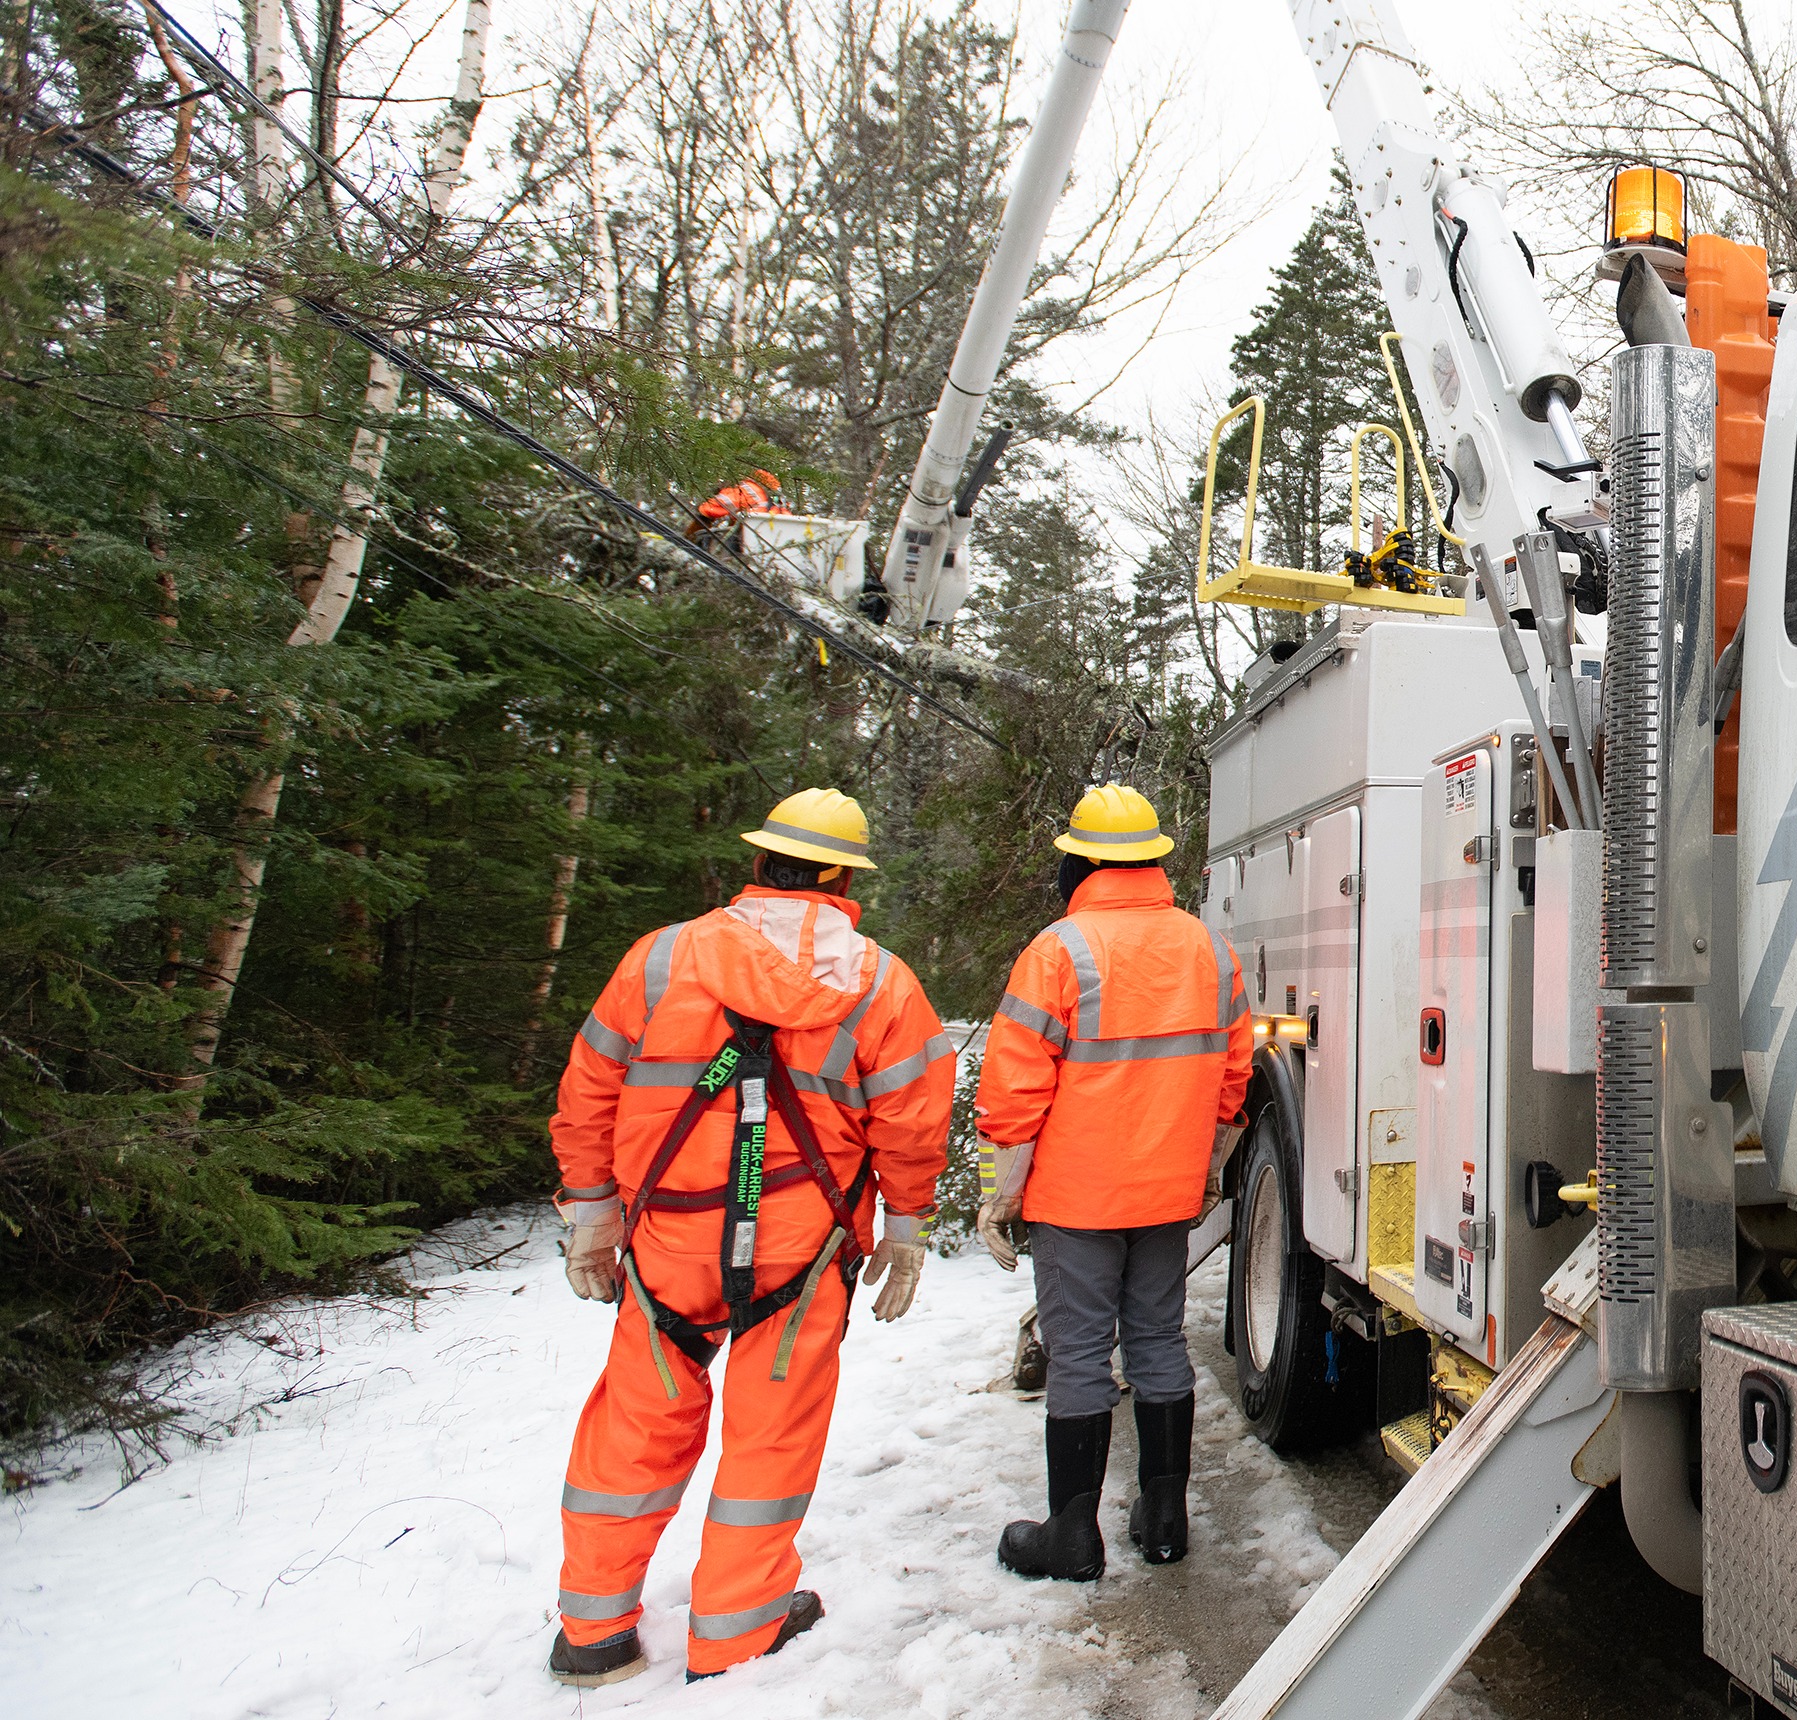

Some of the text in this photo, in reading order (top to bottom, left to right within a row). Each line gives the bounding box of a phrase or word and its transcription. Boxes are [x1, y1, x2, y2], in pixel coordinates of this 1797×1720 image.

[698, 1046, 743, 1093] BUCK
[736, 1141, 751, 1203] BUCKINGHAM
[746, 1125, 767, 1218] BUCK-ARREST
